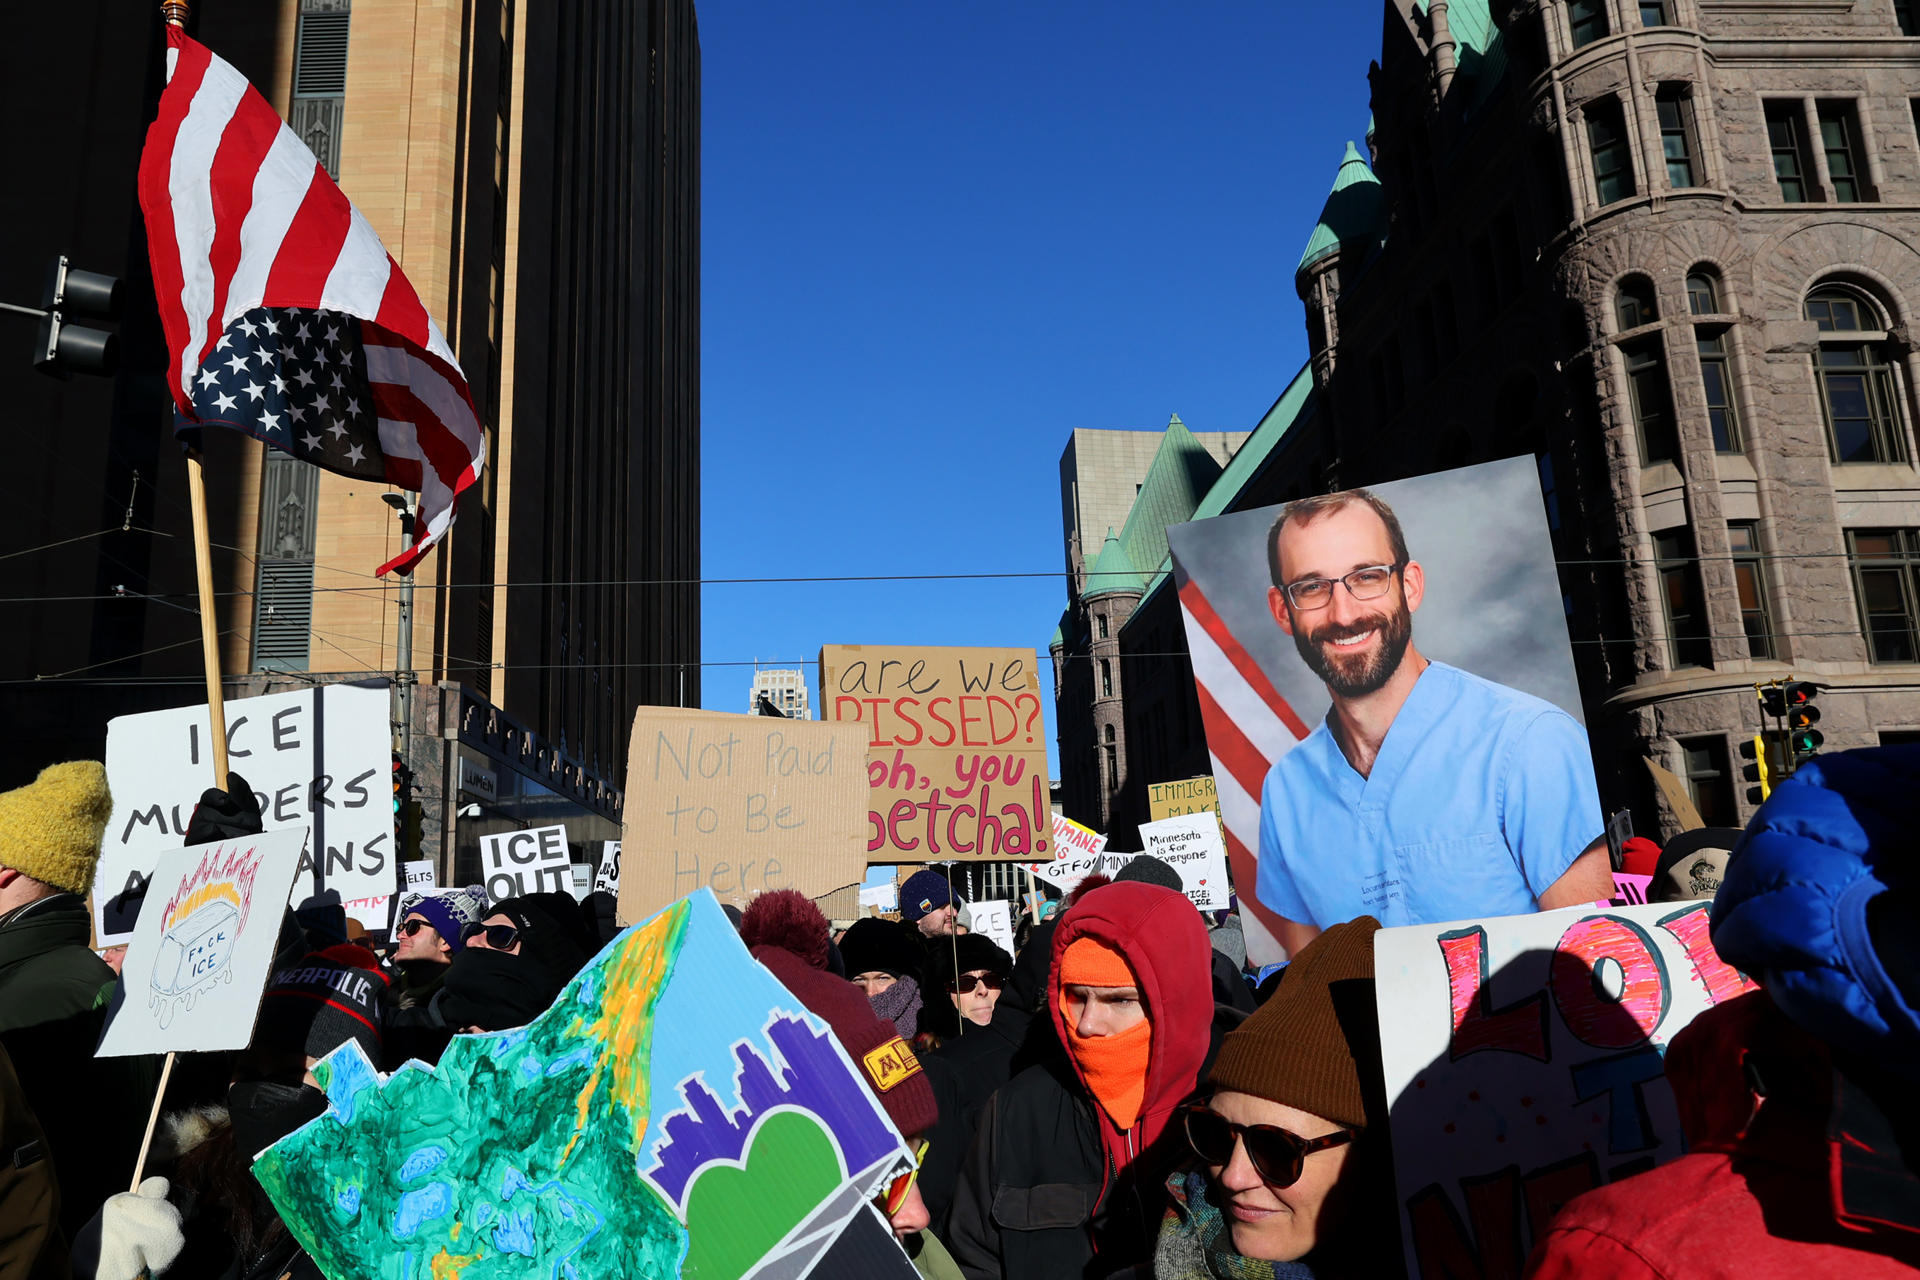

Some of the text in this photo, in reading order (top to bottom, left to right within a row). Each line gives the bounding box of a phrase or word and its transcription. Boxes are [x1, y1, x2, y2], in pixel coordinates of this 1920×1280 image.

[840, 660, 1026, 694] are we
[190, 706, 302, 764] ICE
[655, 728, 834, 781] Not Paid
[465, 768, 494, 794] LUMEN
[868, 749, 1025, 798] oh, you
[666, 794, 805, 836] to Be
[490, 829, 564, 868] ICE
[1149, 830, 1201, 847] Minnesota
[1156, 844, 1187, 856] is for
[487, 864, 571, 903] OUT
[674, 851, 793, 900] Here
[974, 912, 1005, 934] CE
[192, 953, 217, 978] ICE
